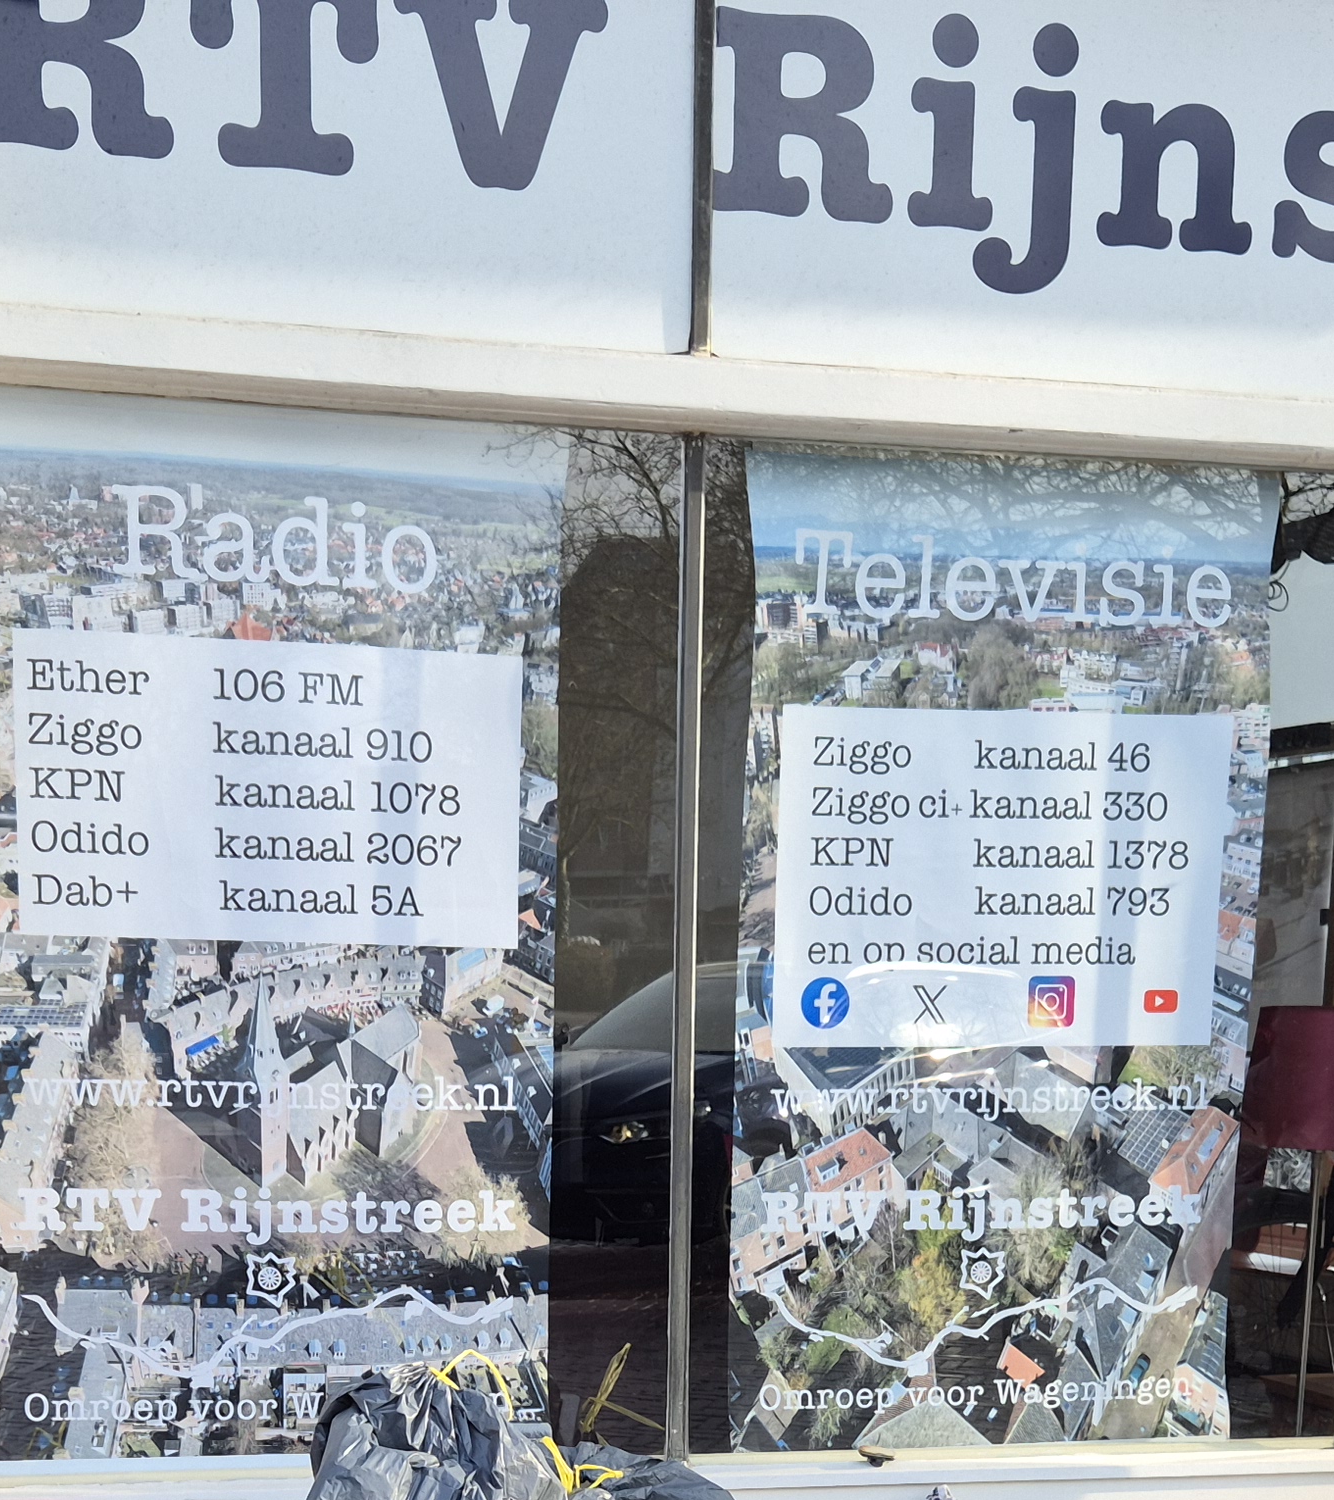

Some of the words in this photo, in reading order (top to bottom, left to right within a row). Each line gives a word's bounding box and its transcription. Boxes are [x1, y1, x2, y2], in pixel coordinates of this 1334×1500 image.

[110, 484, 438, 594] Radio
[794, 527, 1232, 628] Televisie
[26, 658, 150, 696] Ether
[212, 667, 285, 703] 106
[298, 673, 365, 707] FM
[27, 712, 143, 756] Ziggo
[212, 720, 353, 761] kanaal
[365, 729, 433, 763] 910
[812, 736, 912, 776] Ziggo
[973, 739, 1097, 772] kanaal
[1107, 742, 1151, 773] 46
[28, 767, 125, 802] KPN
[214, 775, 355, 813] kanaal
[369, 782, 462, 816] 1078
[810, 786, 910, 826] Ziggo
[969, 789, 1092, 820] kanaal
[1102, 791, 1168, 821] 330
[30, 820, 150, 857] Odido
[214, 827, 355, 862] kanaal
[366, 833, 462, 868] 2067
[809, 837, 894, 868] KPN
[972, 839, 1095, 870] kanaal
[1107, 841, 1190, 872] 1378
[31, 873, 139, 908] Dab+
[219, 880, 358, 916] kanaal
[371, 886, 424, 918] 5A
[808, 886, 913, 917] Odido
[973, 886, 1096, 917] kanaal
[1107, 886, 1170, 917] 793
[807, 940, 852, 965] en
[916, 936, 1019, 965] social
[1030, 936, 1136, 966] media
[19, 1187, 161, 1232] RTV
[181, 1186, 517, 1246] Rijnstreek
[760, 1190, 890, 1236] RTV
[903, 1185, 1201, 1241] Rijnstreek
[23, 1391, 177, 1423] Omroep
[190, 1397, 279, 1421] voor
[759, 1382, 900, 1414] Omroep
[908, 1383, 985, 1409] voor
[993, 1374, 1194, 1407] Wageningen
